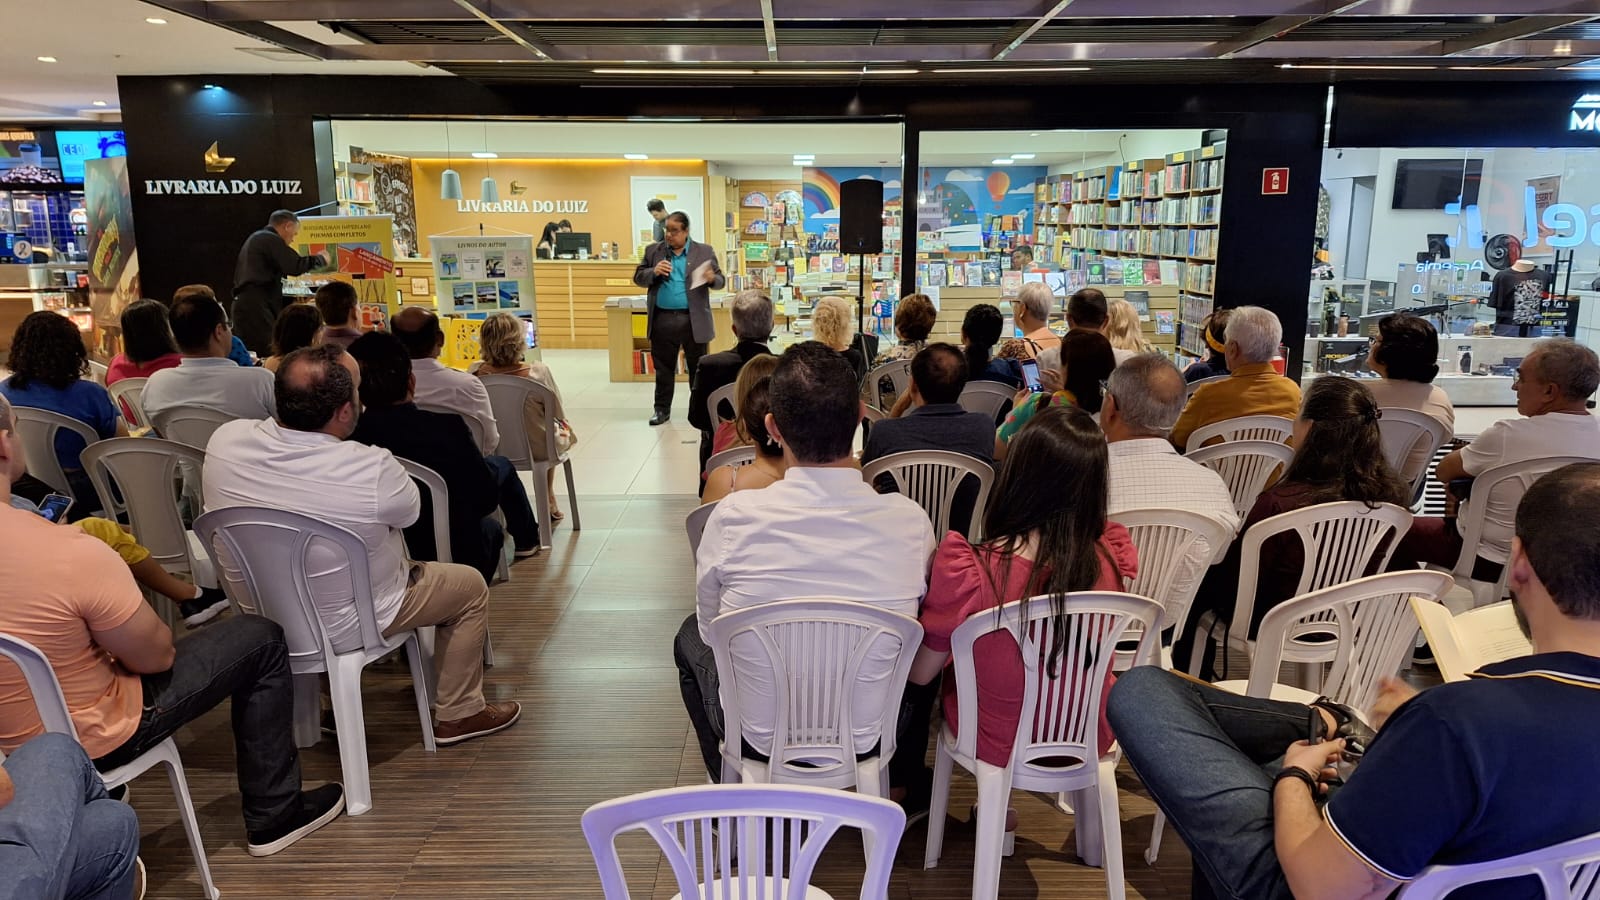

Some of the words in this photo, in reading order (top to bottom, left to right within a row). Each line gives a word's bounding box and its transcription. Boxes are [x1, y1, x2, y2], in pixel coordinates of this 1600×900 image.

[1570, 109, 1600, 132] M
[145, 180, 229, 194] LIVRARIA
[230, 180, 257, 194] DO
[261, 180, 302, 194] LUIZ
[457, 200, 529, 213] LIVRARIA
[533, 200, 553, 213] DO
[557, 200, 588, 213] LUIZ
